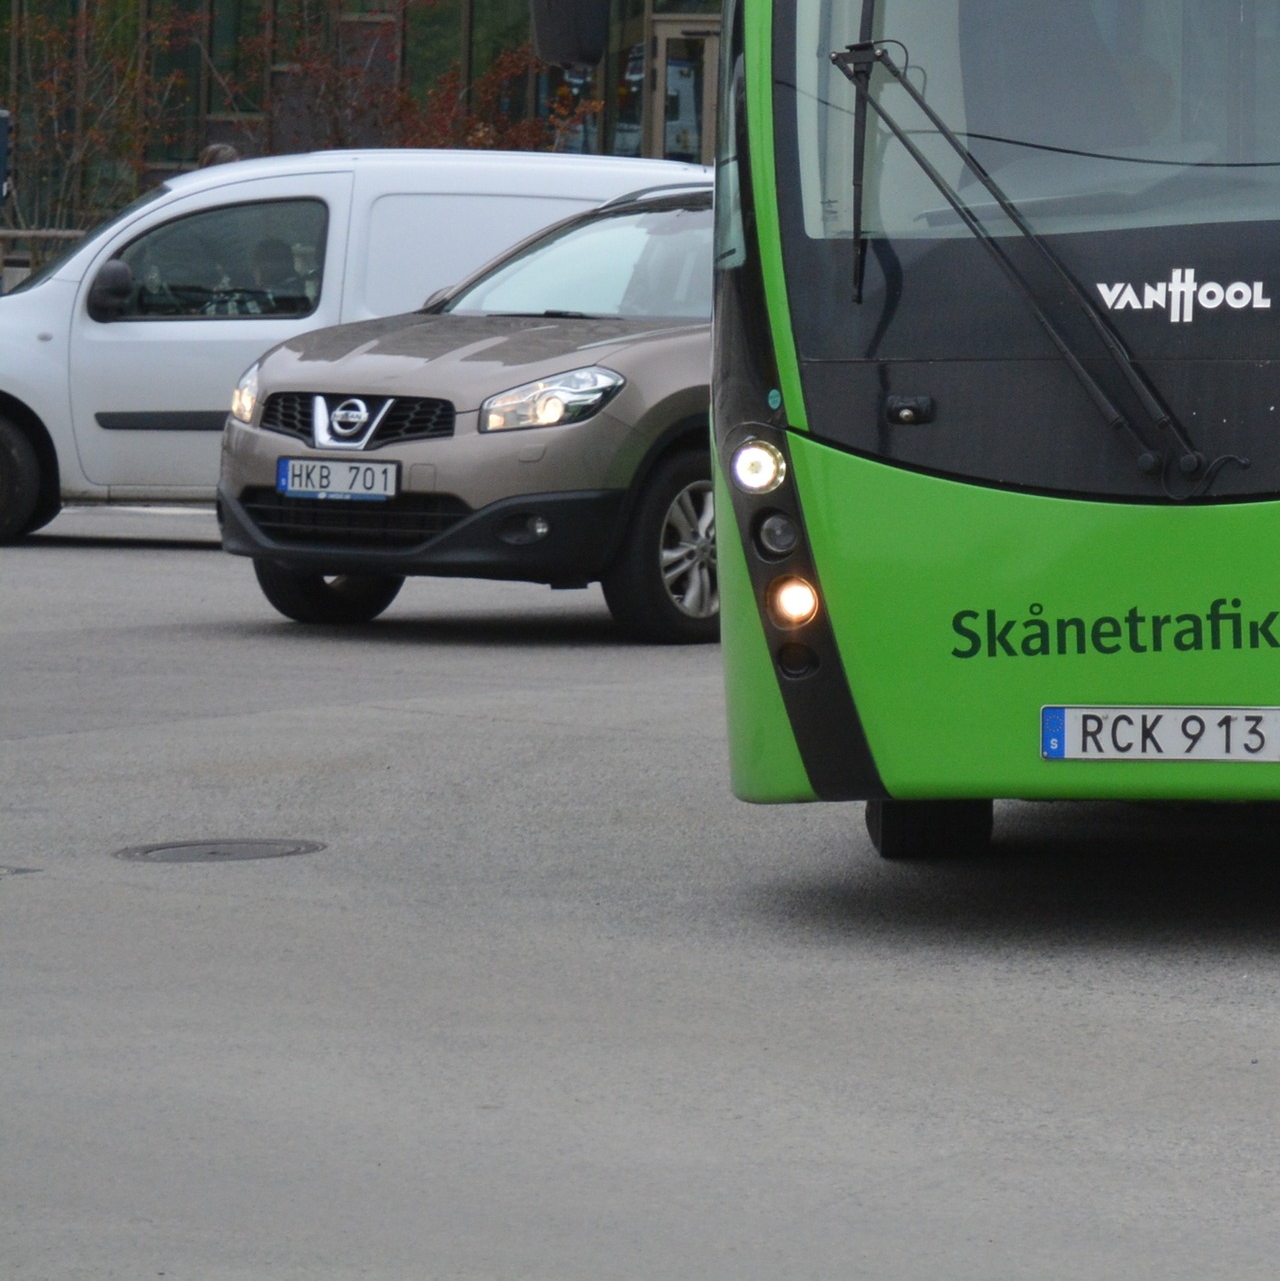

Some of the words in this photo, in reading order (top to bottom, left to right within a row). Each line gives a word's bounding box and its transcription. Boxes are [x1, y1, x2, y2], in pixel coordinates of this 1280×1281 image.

[291, 464, 331, 489] HKB
[348, 466, 389, 491] 701
[1050, 738, 1058, 750] S
[1080, 714, 1164, 754] RCK
[1180, 714, 1267, 754] 913
